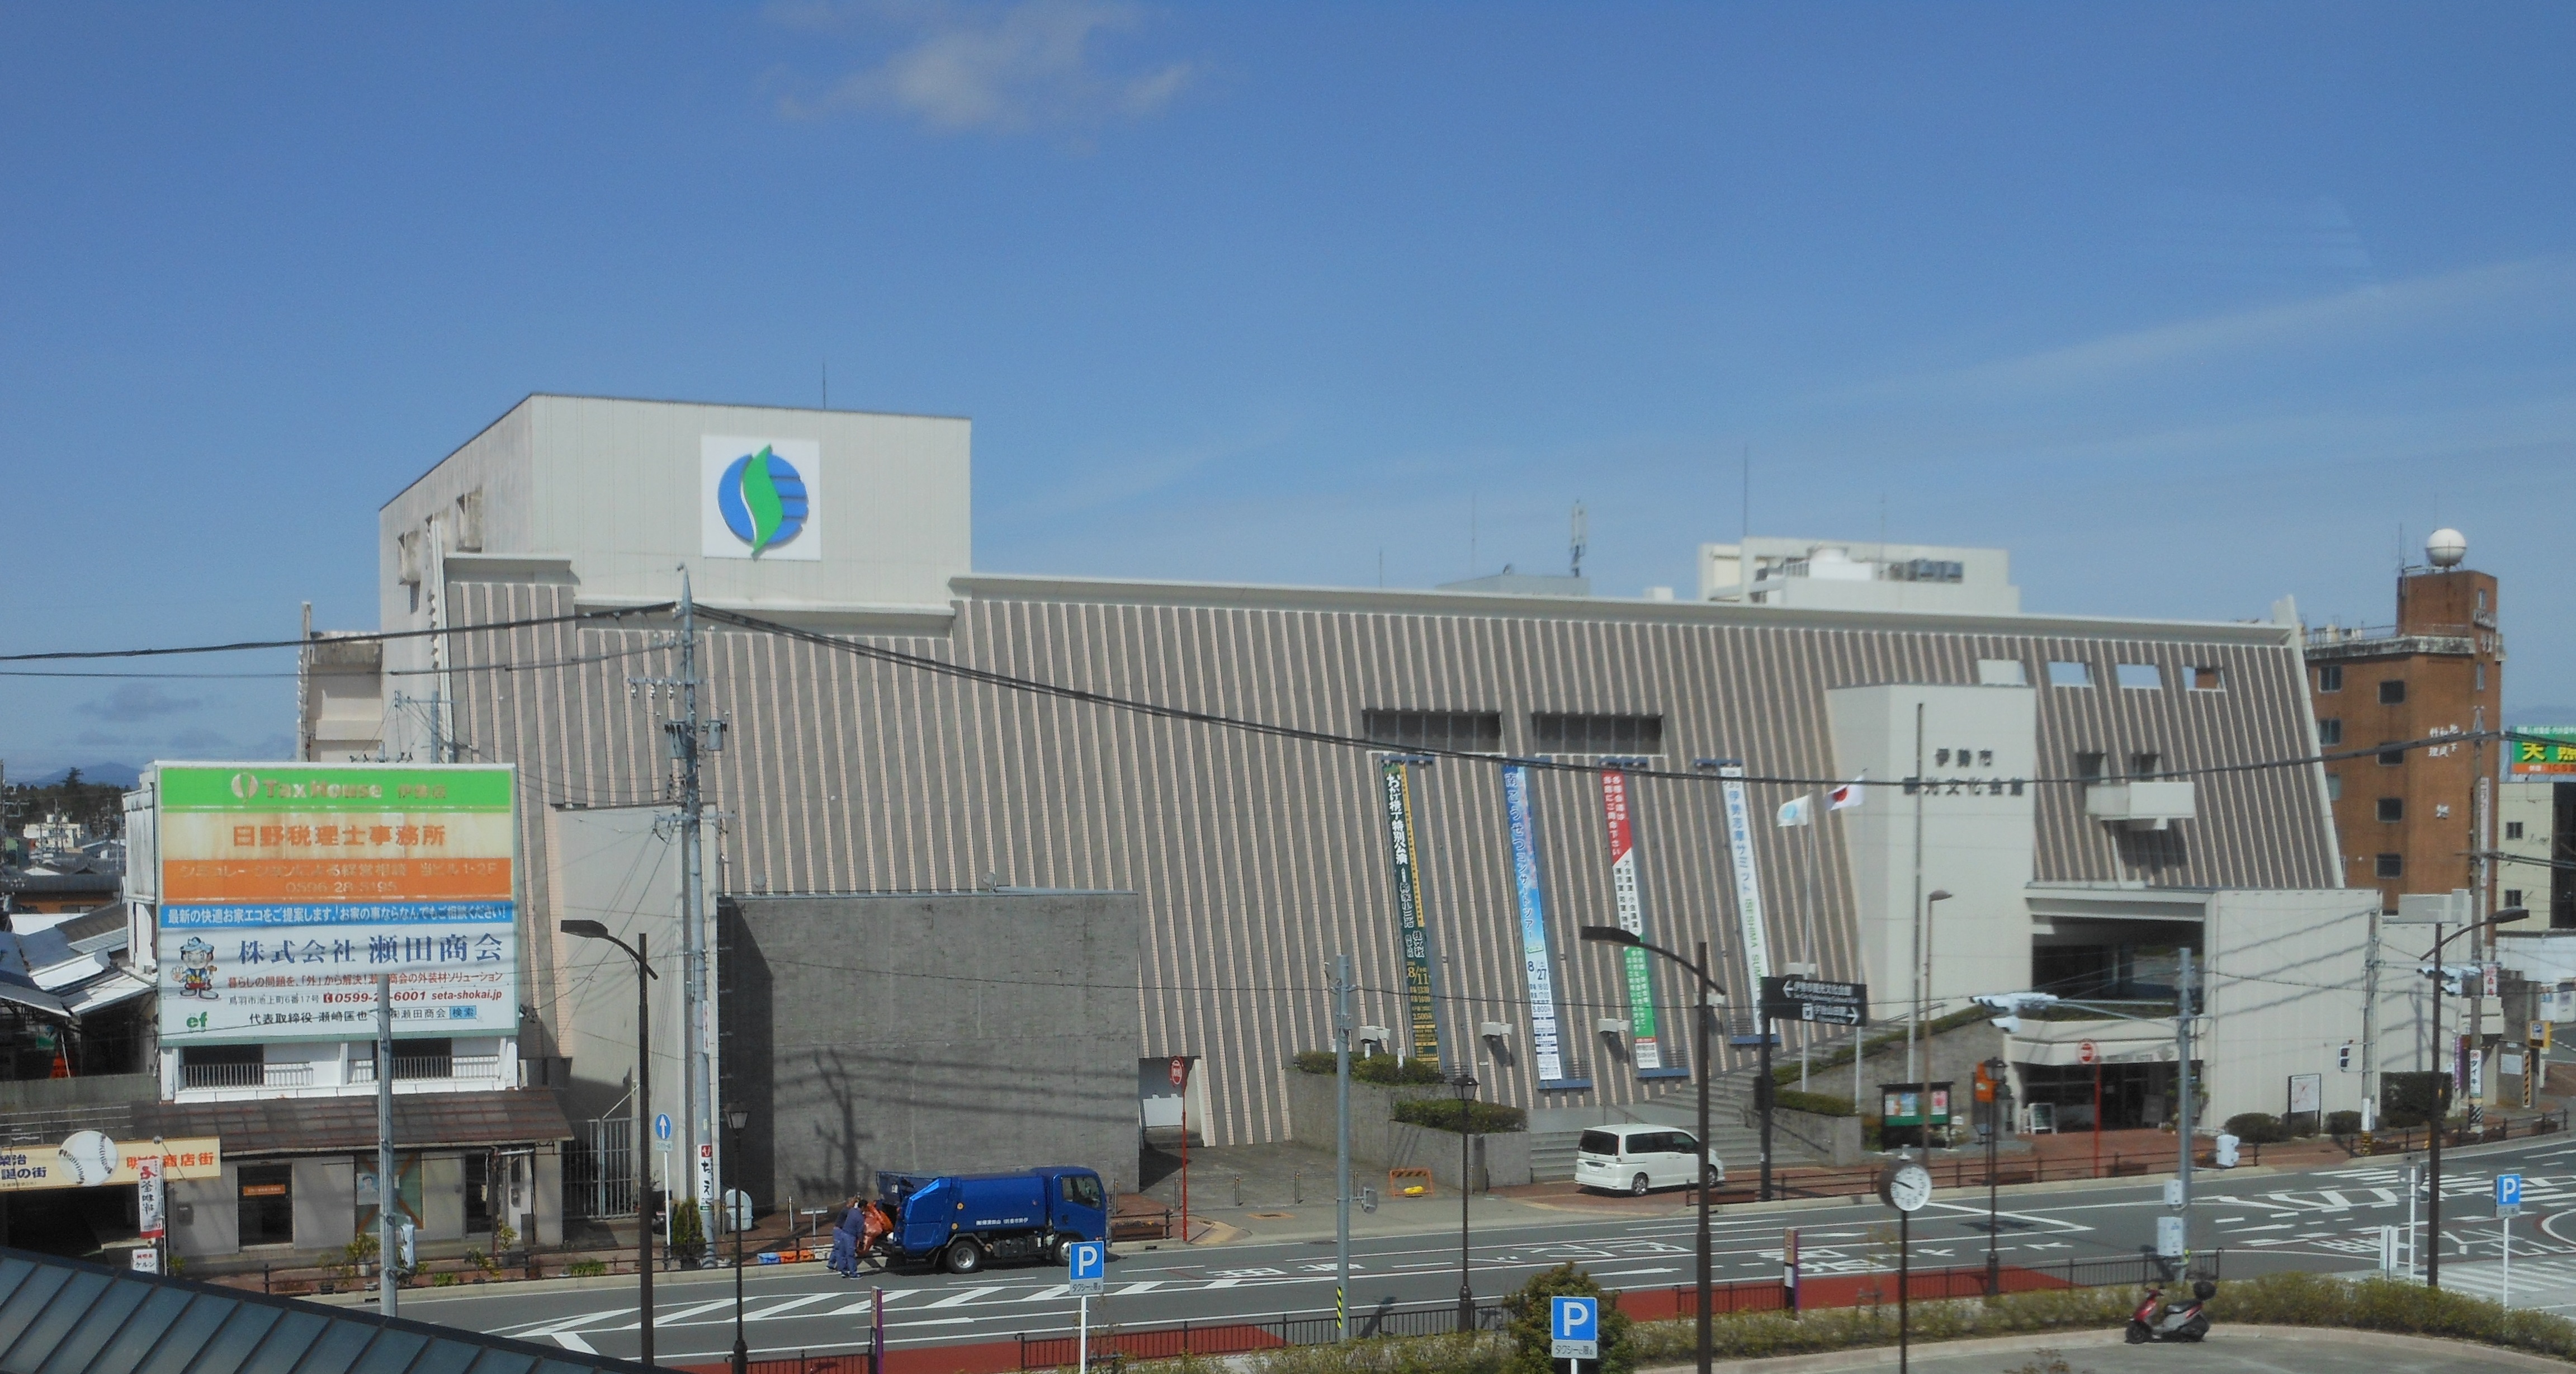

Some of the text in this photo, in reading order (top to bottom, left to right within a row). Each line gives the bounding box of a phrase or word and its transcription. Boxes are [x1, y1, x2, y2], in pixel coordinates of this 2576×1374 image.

[1935, 748, 1993, 768] 伊勢市
[233, 825, 446, 847] 日野税理士事務所
[1745, 899, 1758, 948] ISESHIMA
[238, 932, 503, 965] 株式会社 瀬田商会
[335, 990, 426, 1004] 0599-2-6001
[431, 989, 502, 1001] seta-shokai.jp
[249, 1012, 313, 1025] 代表取締役
[451, 1007, 475, 1018] 検索
[126, 1152, 214, 1170] 明商店街
[2503, 1178, 2516, 1202] P
[1078, 1245, 1098, 1276] P
[1563, 1301, 1589, 1337] P
